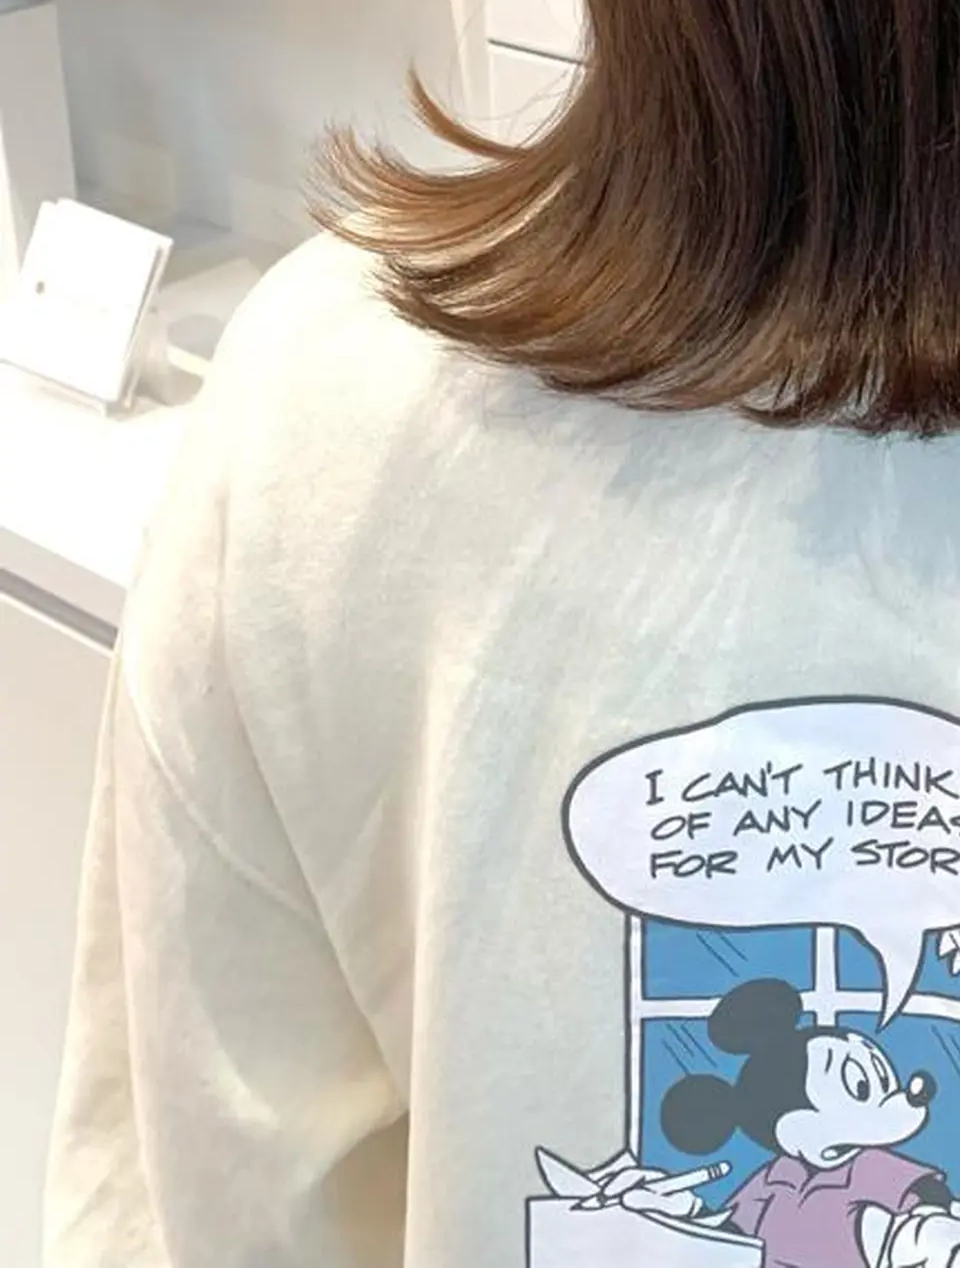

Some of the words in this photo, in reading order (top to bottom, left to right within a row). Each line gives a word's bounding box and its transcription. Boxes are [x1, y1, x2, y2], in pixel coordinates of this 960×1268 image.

[645, 769, 665, 806] I
[681, 761, 803, 803] CAN'T
[823, 756, 960, 800] THINK
[650, 811, 712, 841] OF
[732, 799, 822, 837] ANY
[650, 849, 739, 879] FOR
[766, 836, 834, 872] MY
